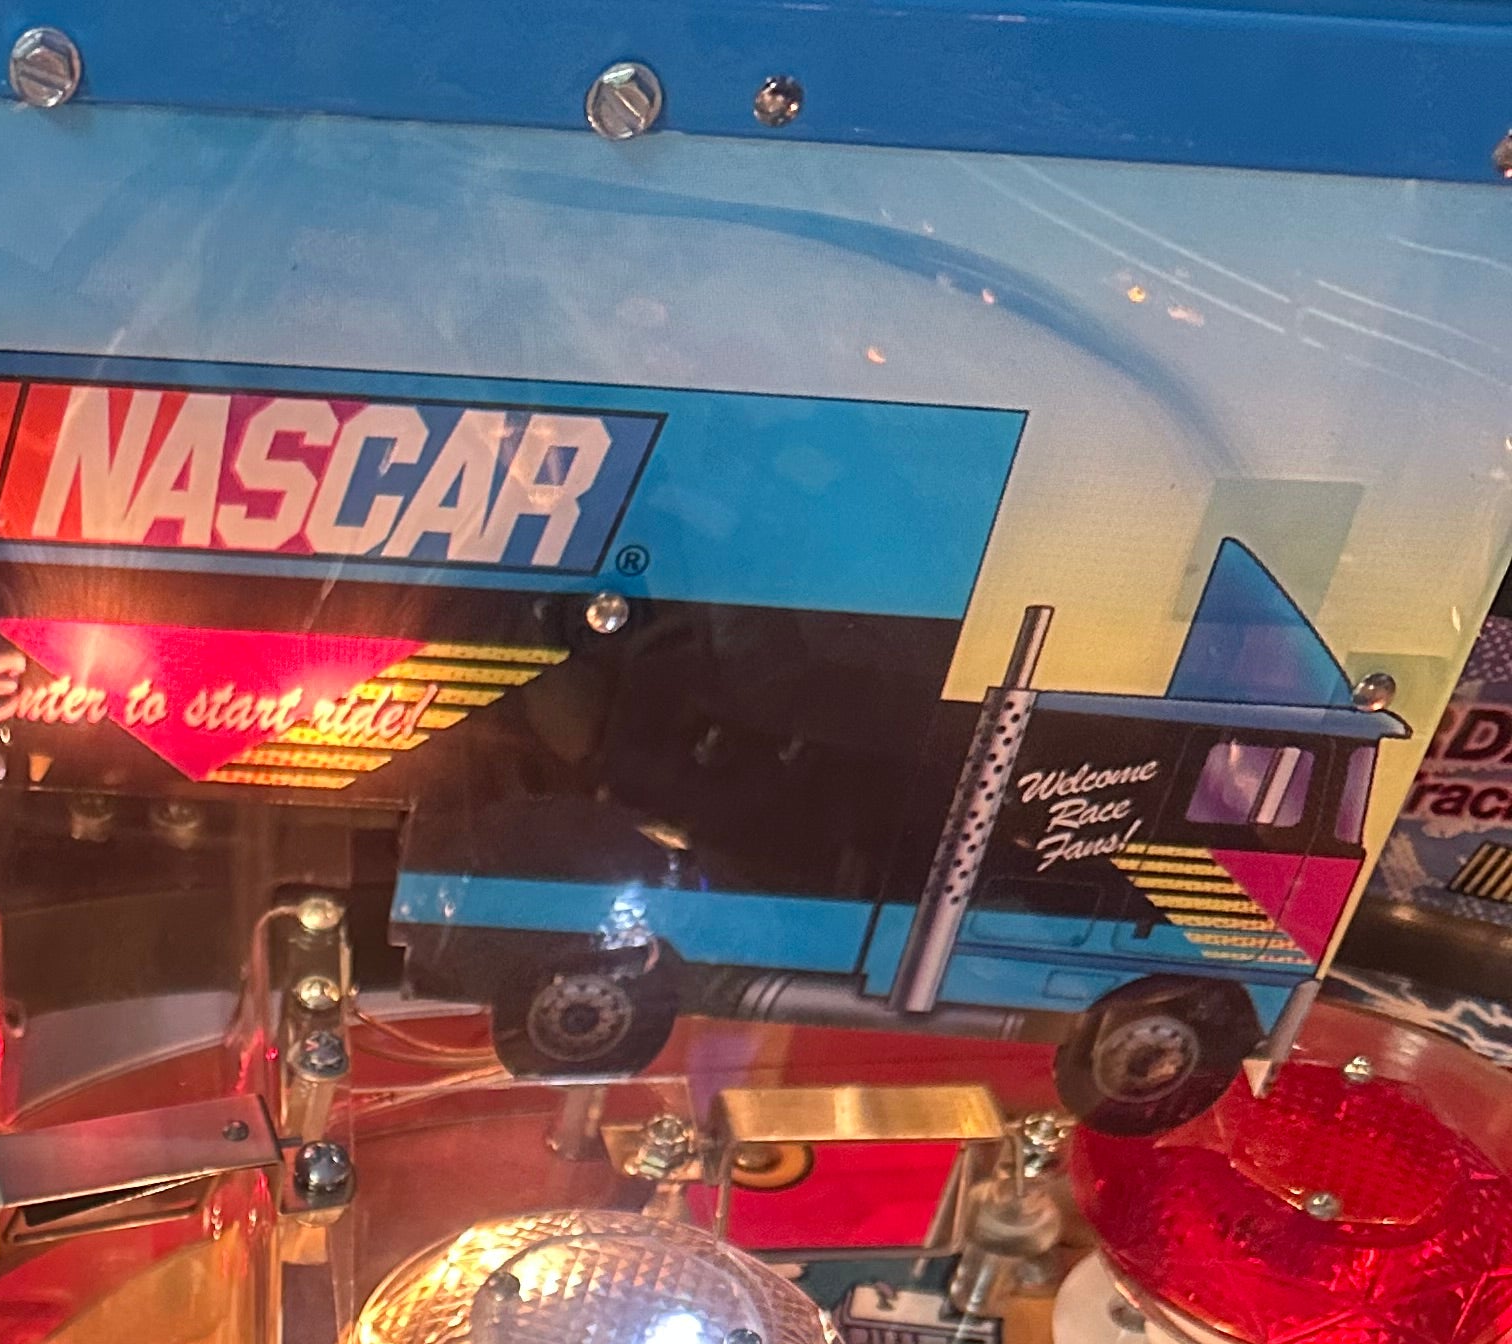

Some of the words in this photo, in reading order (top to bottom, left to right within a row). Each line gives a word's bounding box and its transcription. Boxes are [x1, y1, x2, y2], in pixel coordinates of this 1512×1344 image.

[31, 384, 612, 567] NASCAR
[124, 679, 167, 724] to
[184, 686, 296, 733] start
[308, 684, 440, 738] ride!
[1018, 761, 1158, 801] Welcome
[1047, 800, 1131, 833] Race
[1035, 820, 1143, 872] Fans!
